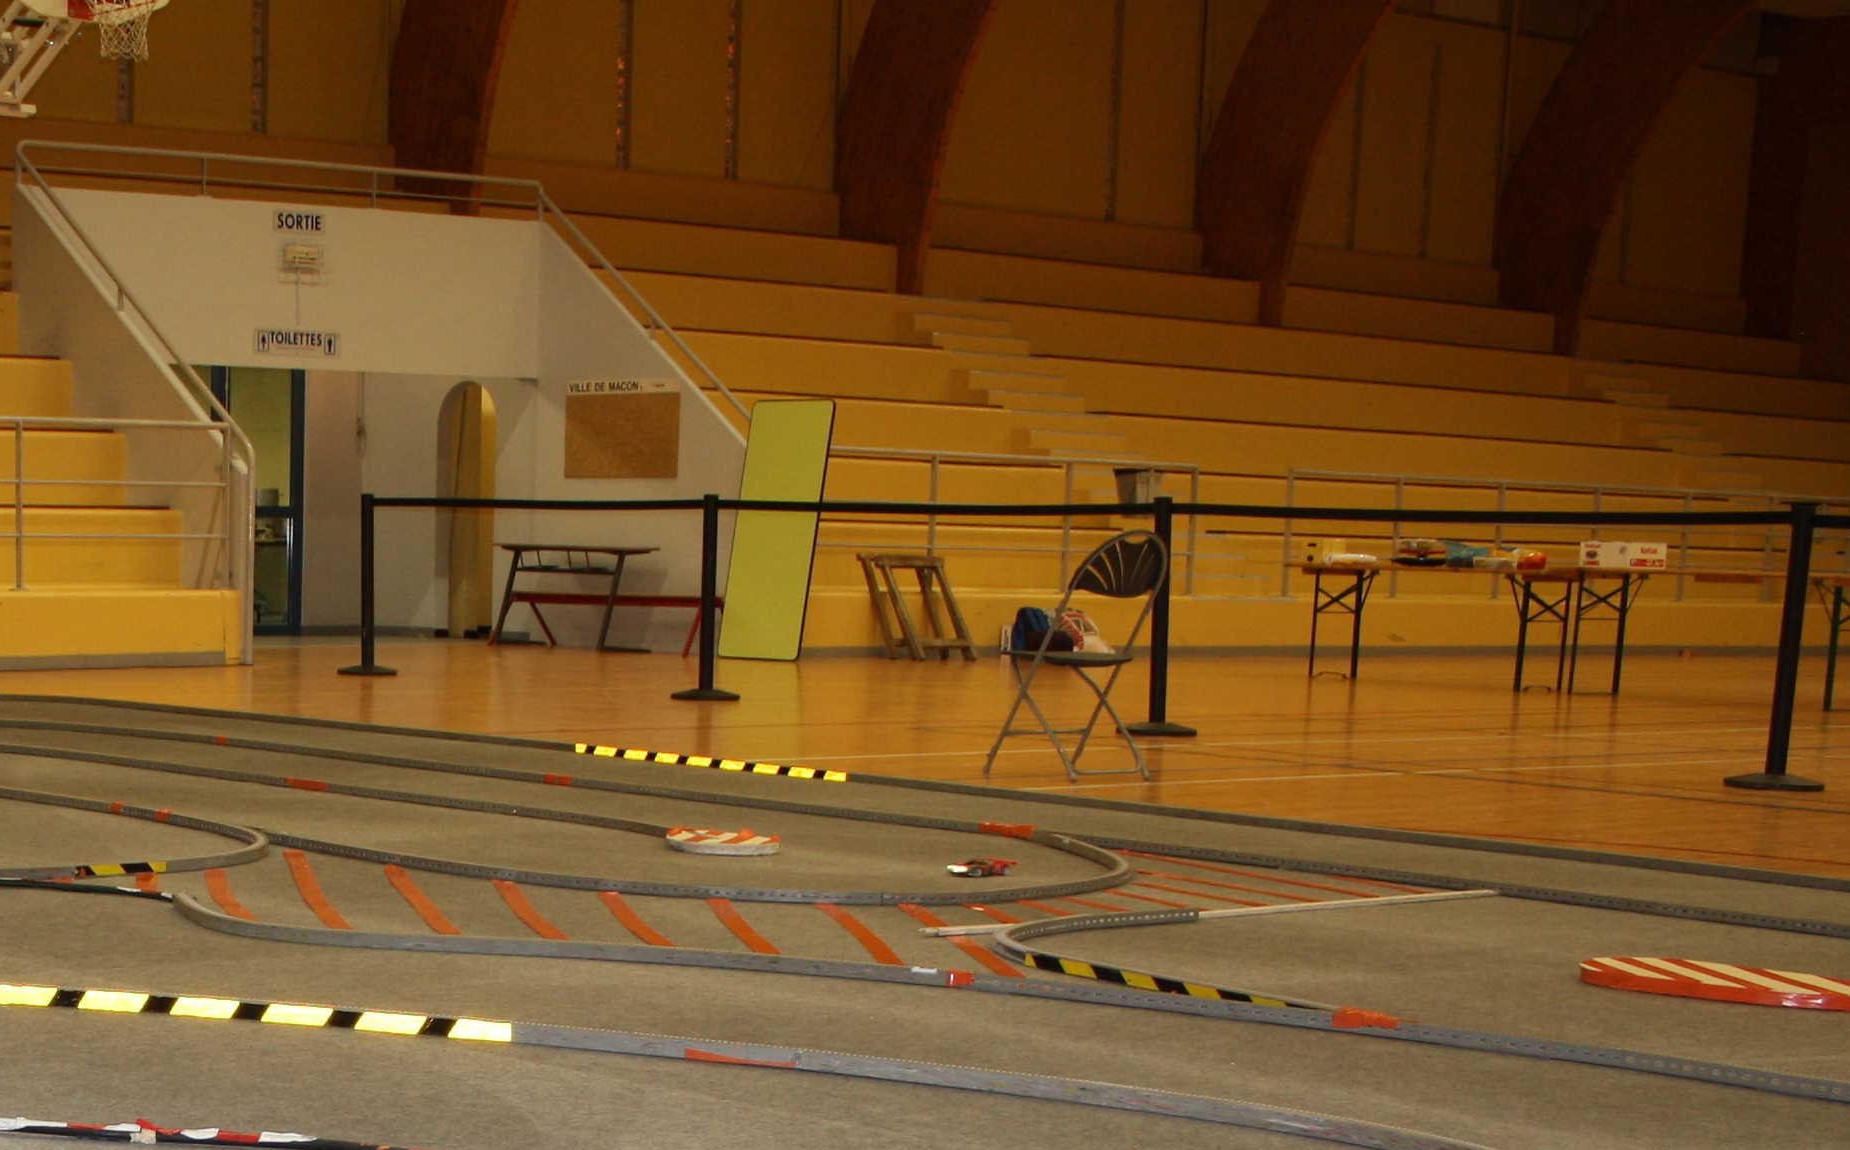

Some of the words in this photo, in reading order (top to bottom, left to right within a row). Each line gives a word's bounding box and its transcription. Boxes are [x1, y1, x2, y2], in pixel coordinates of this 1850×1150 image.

[277, 212, 322, 231] SORTIE
[270, 331, 322, 346] TOILETTES
[568, 383, 591, 393] VILLE
[594, 382, 605, 392] DE
